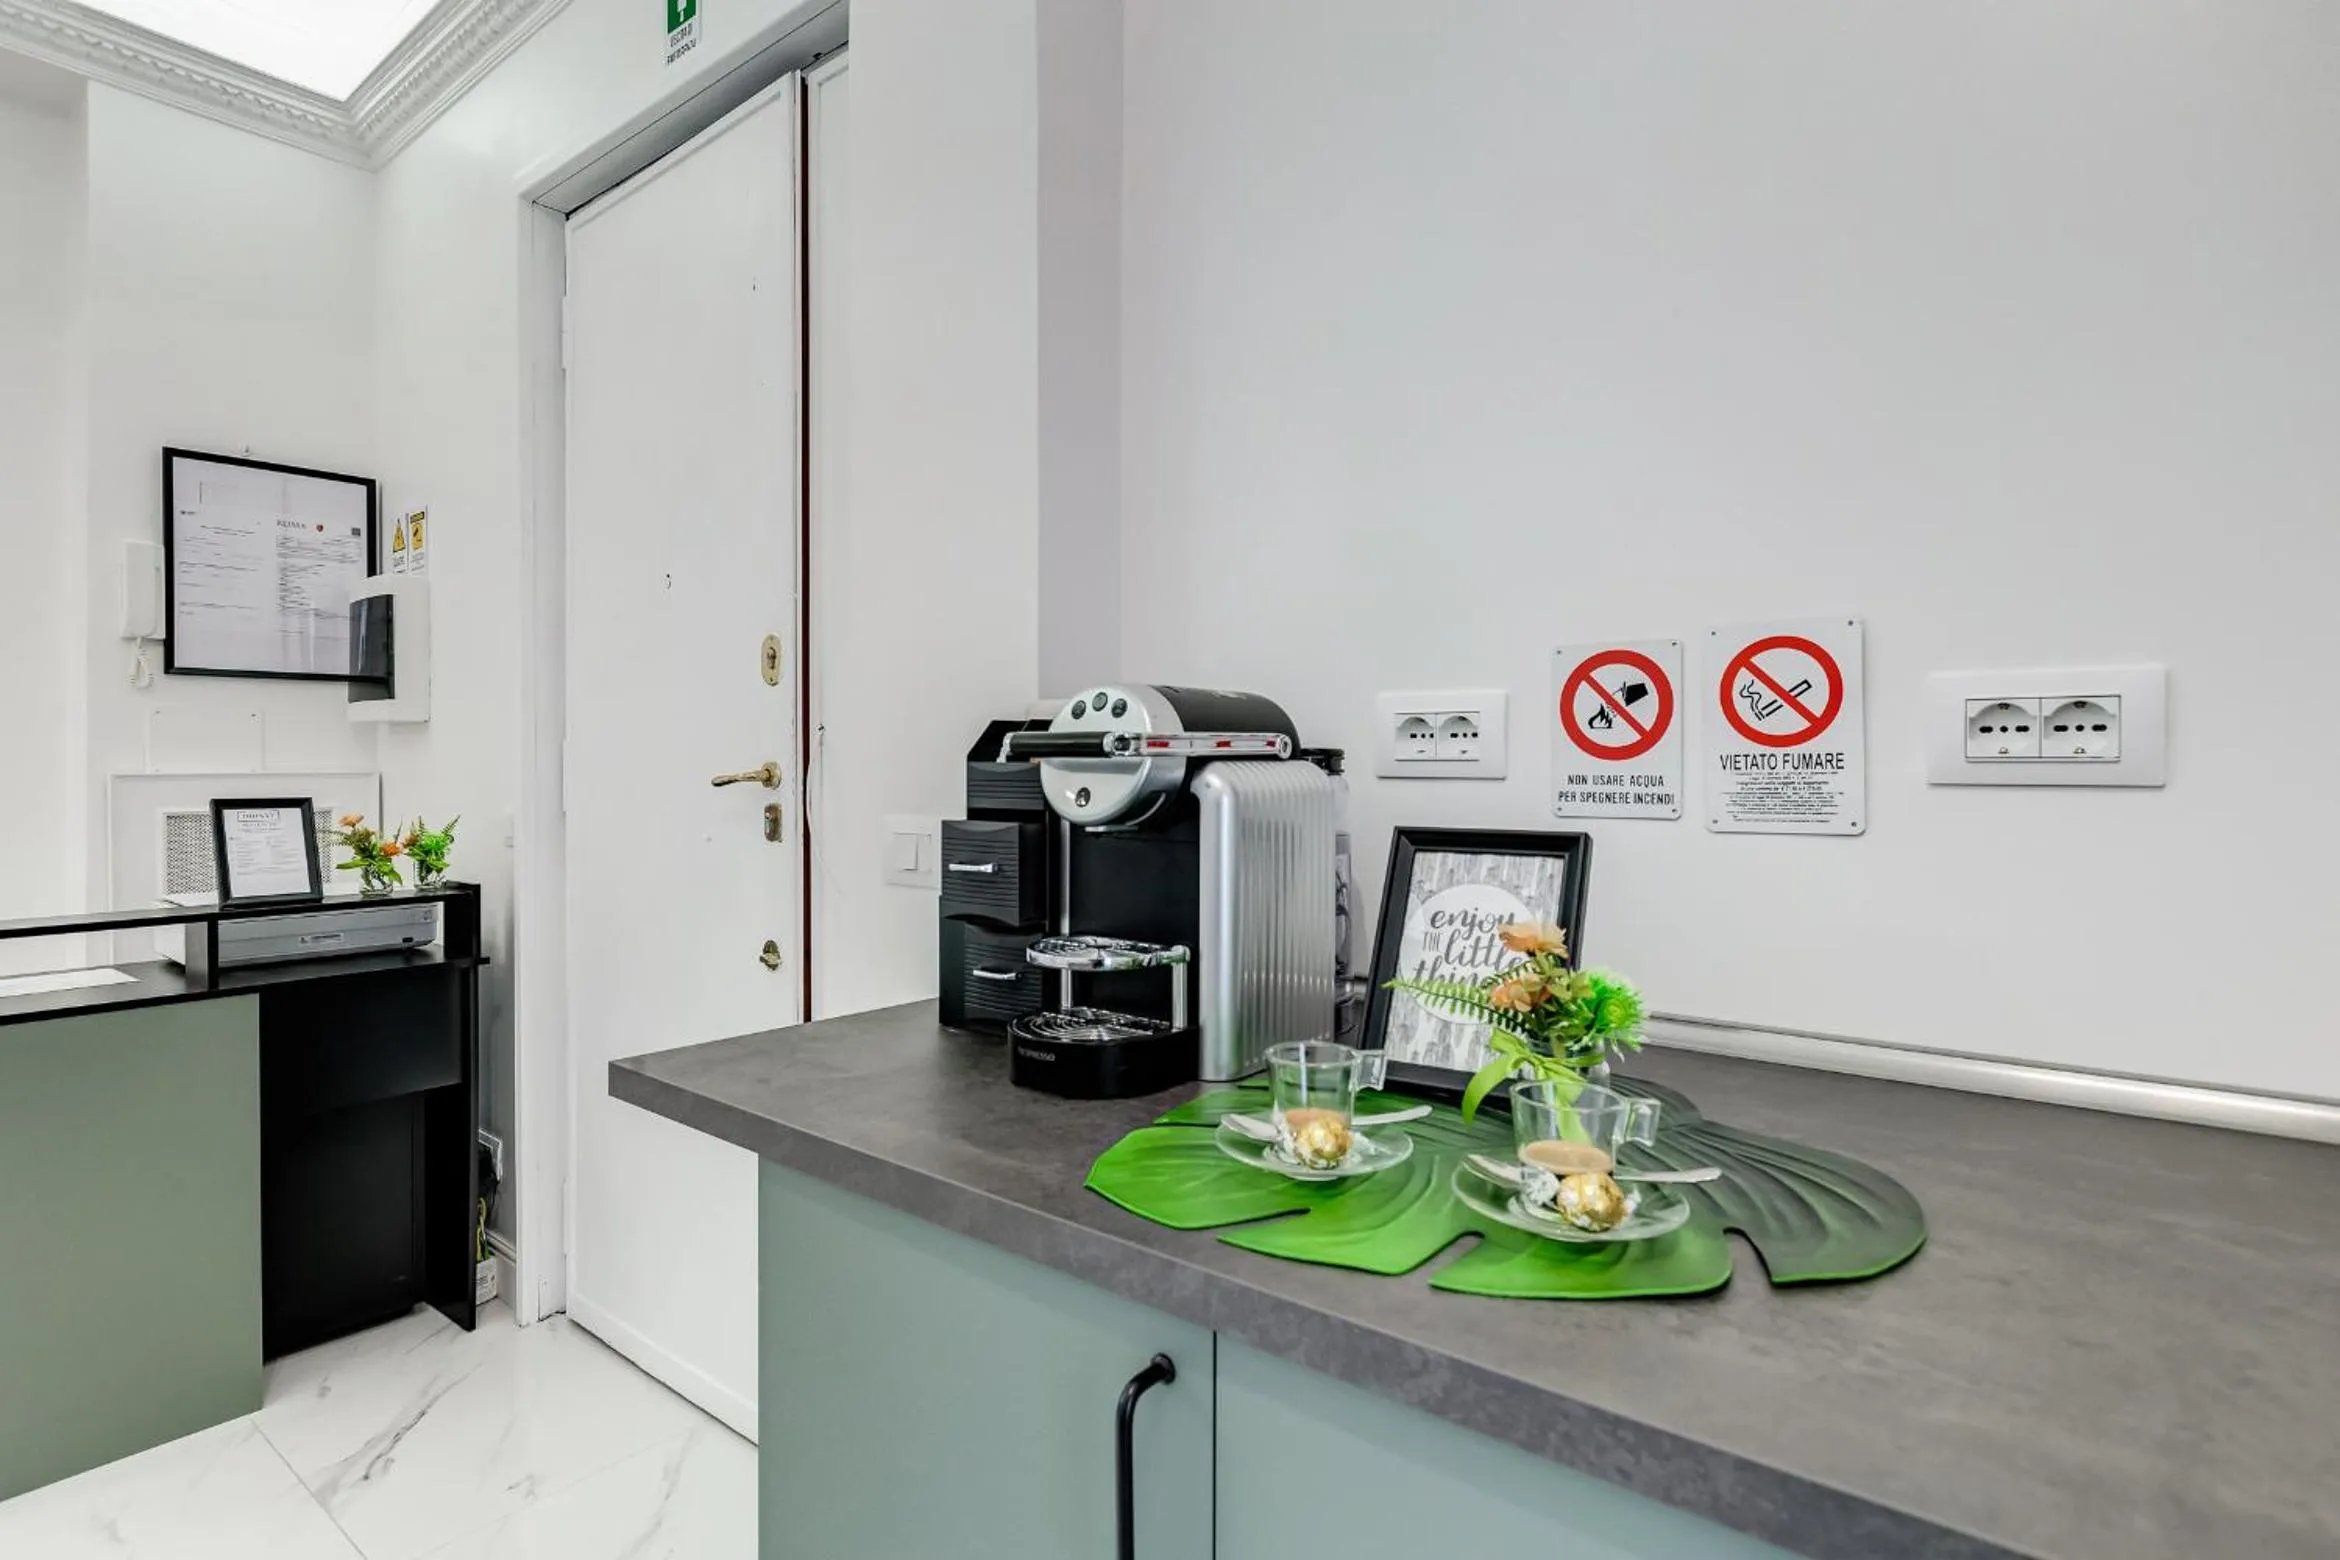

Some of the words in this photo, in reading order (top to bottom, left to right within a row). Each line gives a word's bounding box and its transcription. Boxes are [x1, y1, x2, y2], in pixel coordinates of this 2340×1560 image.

[1720, 753, 1778, 771] VIETATO
[1782, 752, 1845, 771] FUMARE
[1568, 775, 1588, 787] NON
[1592, 775, 1625, 788] USARE
[1630, 776, 1665, 790] ACQUA
[1558, 792, 1576, 803] PER
[1580, 791, 1631, 804] SPEGNERE
[1633, 793, 1676, 806] INCENDI
